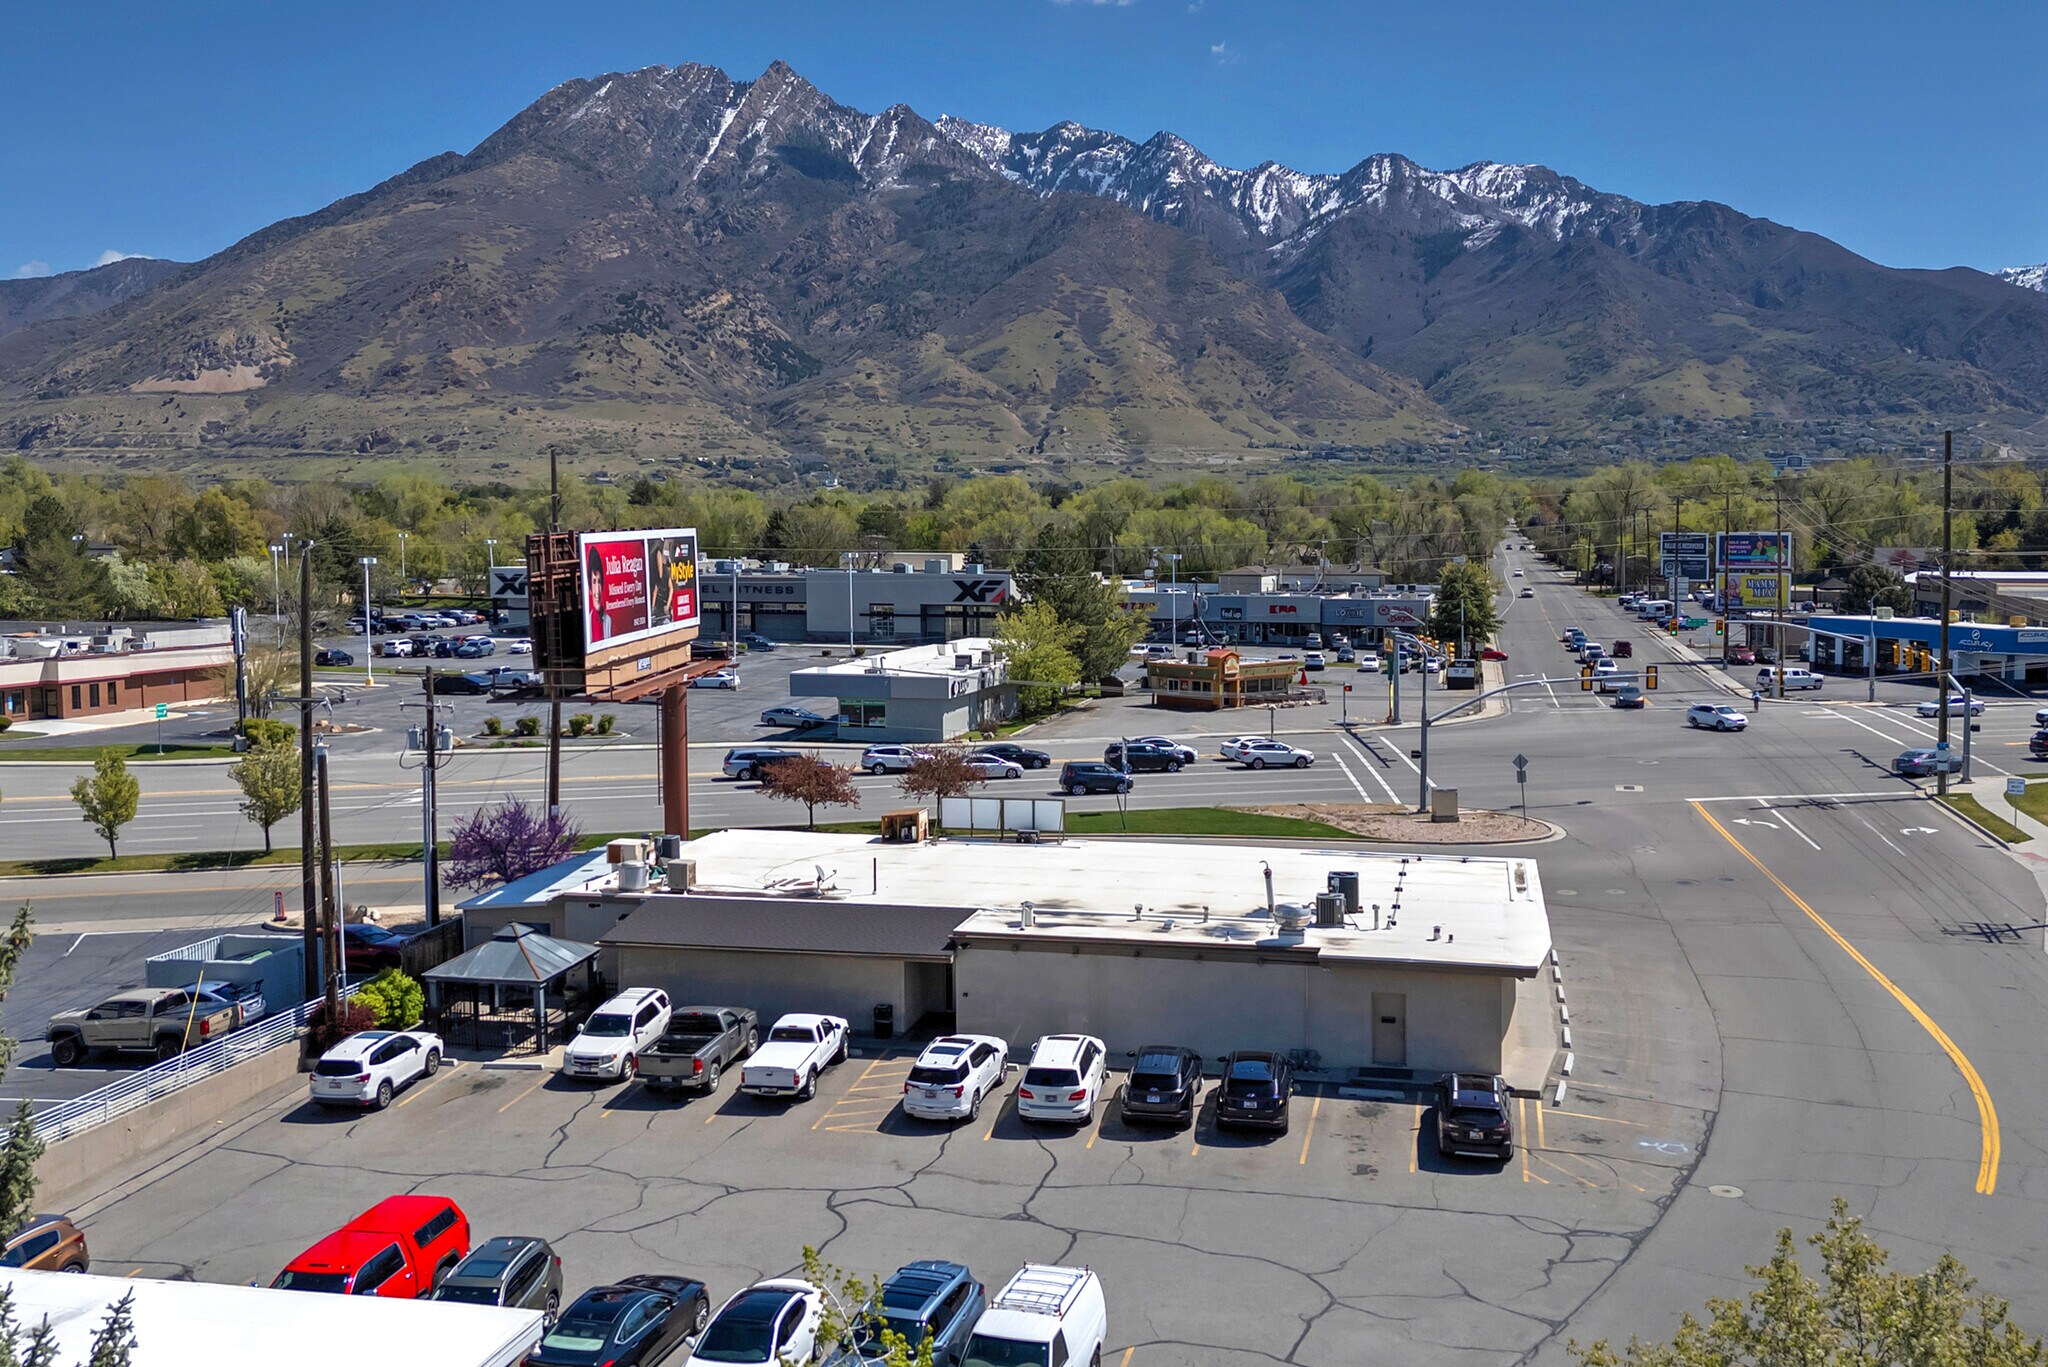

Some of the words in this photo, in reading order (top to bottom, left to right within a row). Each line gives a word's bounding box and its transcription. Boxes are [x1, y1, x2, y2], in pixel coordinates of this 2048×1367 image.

[605, 555, 621, 575] Julia
[622, 555, 643, 577] Reagan
[671, 560, 694, 584] MyStyle
[729, 586, 794, 594] FITNESS
[953, 580, 1004, 602] XF
[1746, 579, 1776, 588] MAMM
[1958, 639, 1994, 649] ACCURACY
